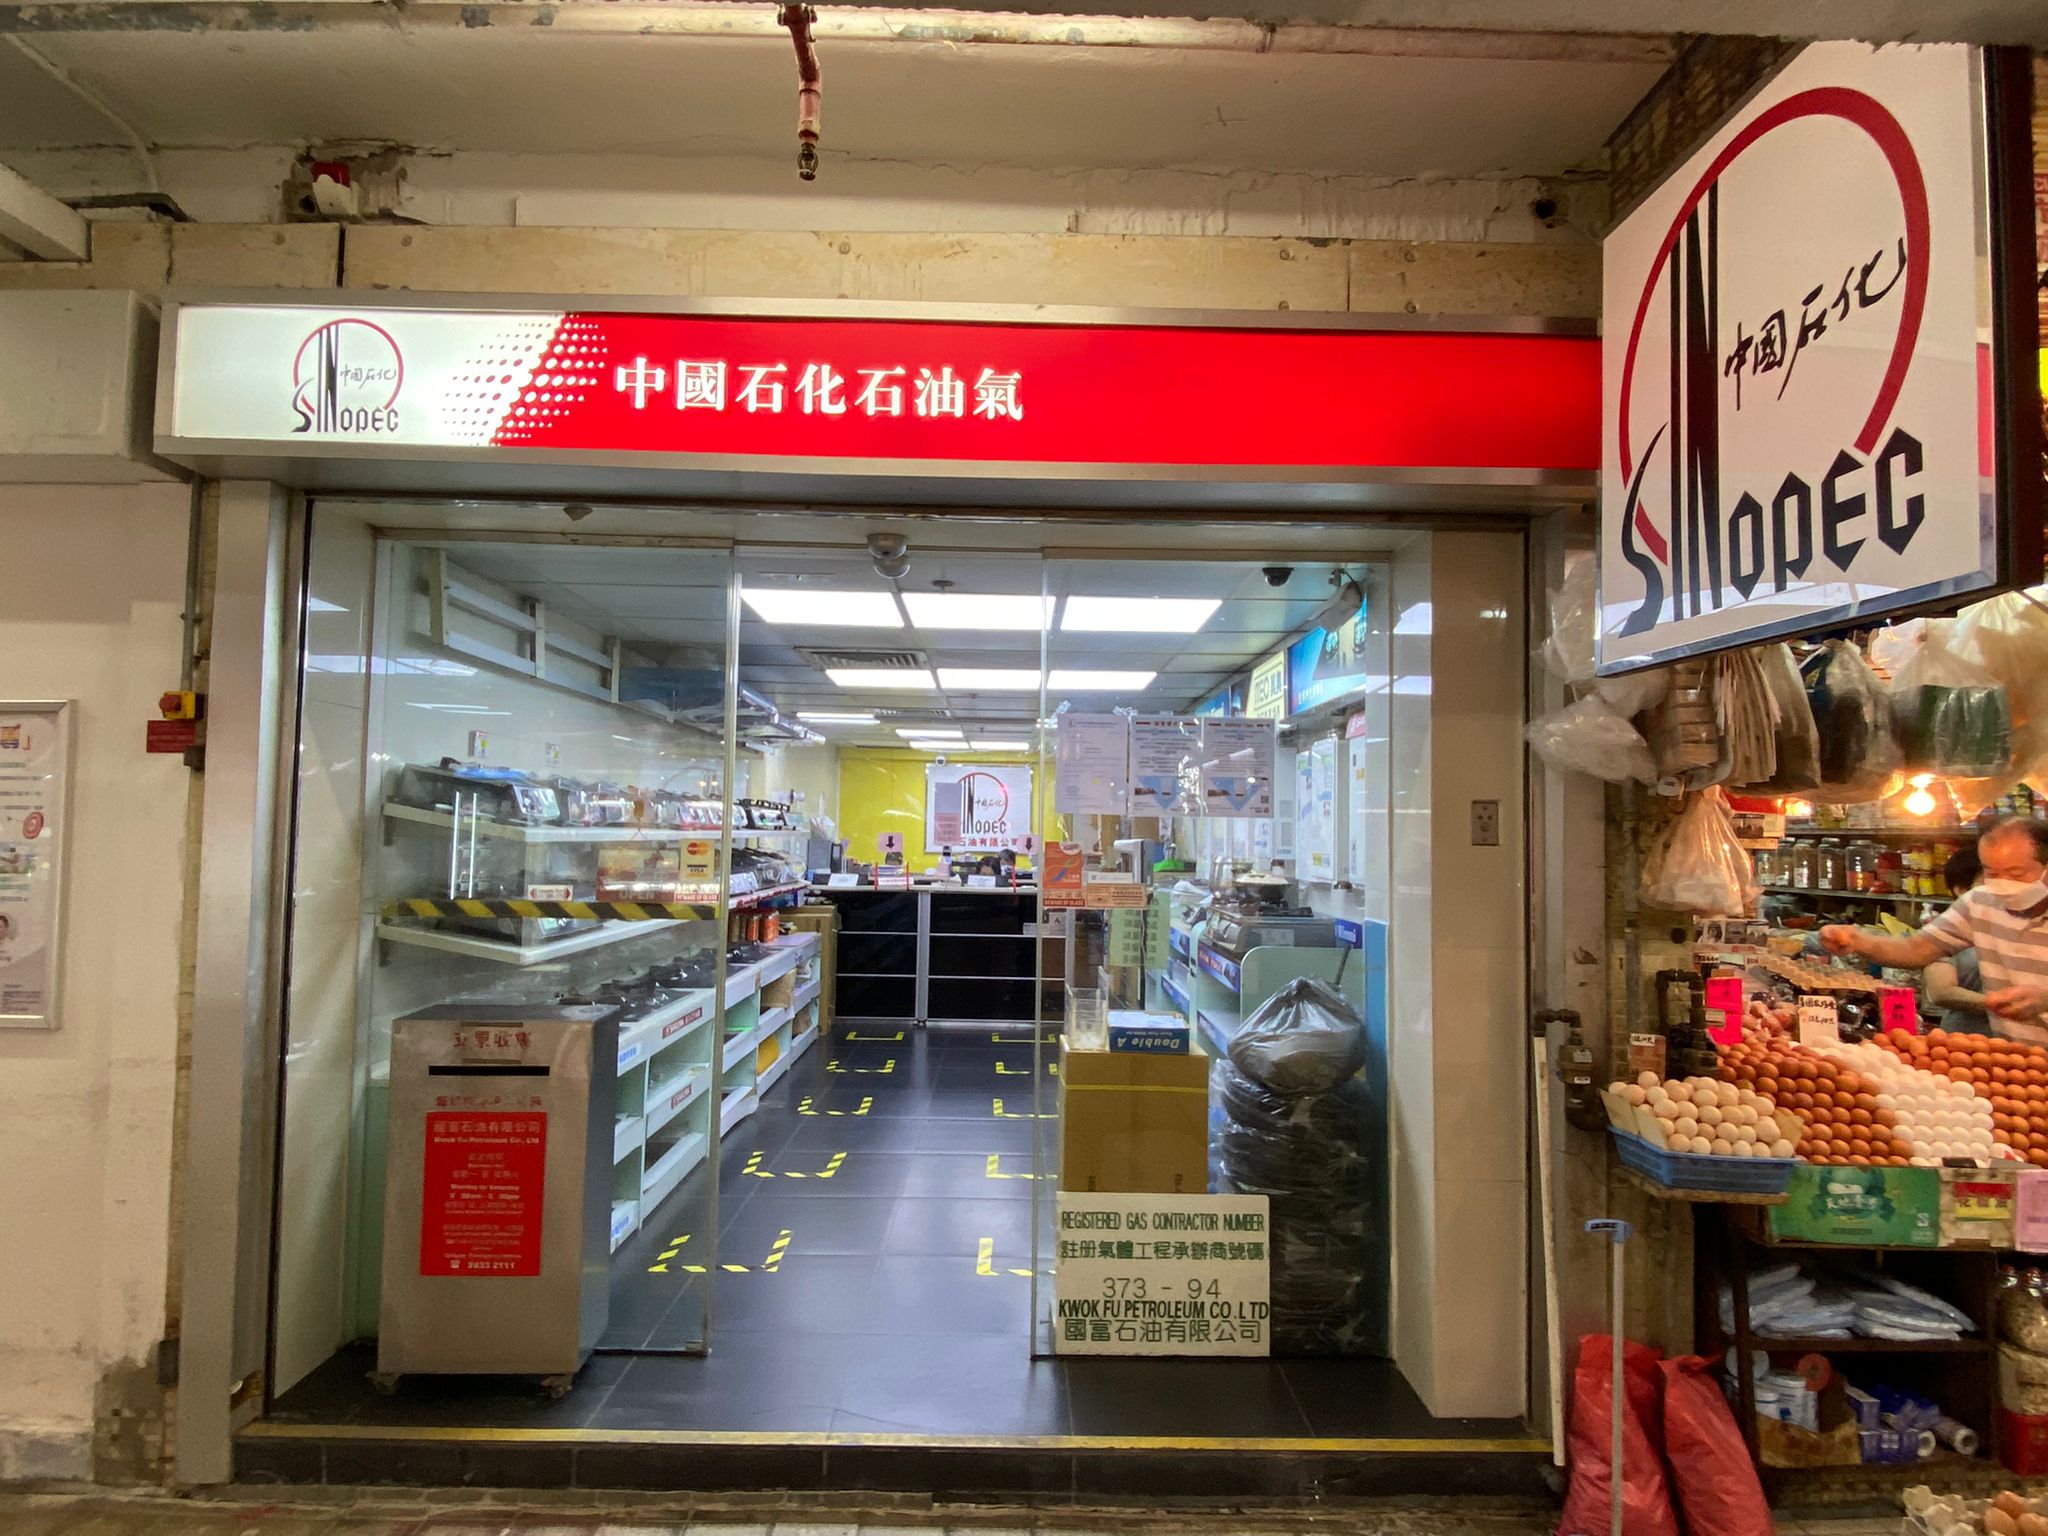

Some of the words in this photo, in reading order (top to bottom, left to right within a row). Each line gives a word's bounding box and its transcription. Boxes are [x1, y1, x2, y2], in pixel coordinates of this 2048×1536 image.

[1723, 237, 1907, 411] 中国石化
[290, 324, 400, 433] SINOPEC
[339, 362, 397, 391] 中国石化
[614, 357, 1025, 422] 中國石化石油氣
[1618, 177, 1927, 639] SINOPEC
[962, 775, 1007, 834] INOPEC
[1116, 1036, 1127, 1048] A
[1131, 1037, 1181, 1049] Double
[1061, 1211, 1121, 1230] REGISTERED
[1126, 1212, 1147, 1230] GAS
[1153, 1213, 1218, 1231] CONTRACTOR
[1223, 1213, 1264, 1232] NUMBER
[1102, 1277, 1147, 1299] 373
[1187, 1279, 1221, 1299] 94
[1059, 1299, 1100, 1318] KWOK
[1103, 1300, 1121, 1318] FU
[1124, 1300, 1205, 1319] PETROLEUM
[1064, 1319, 1261, 1343] 國富石油有限公司
